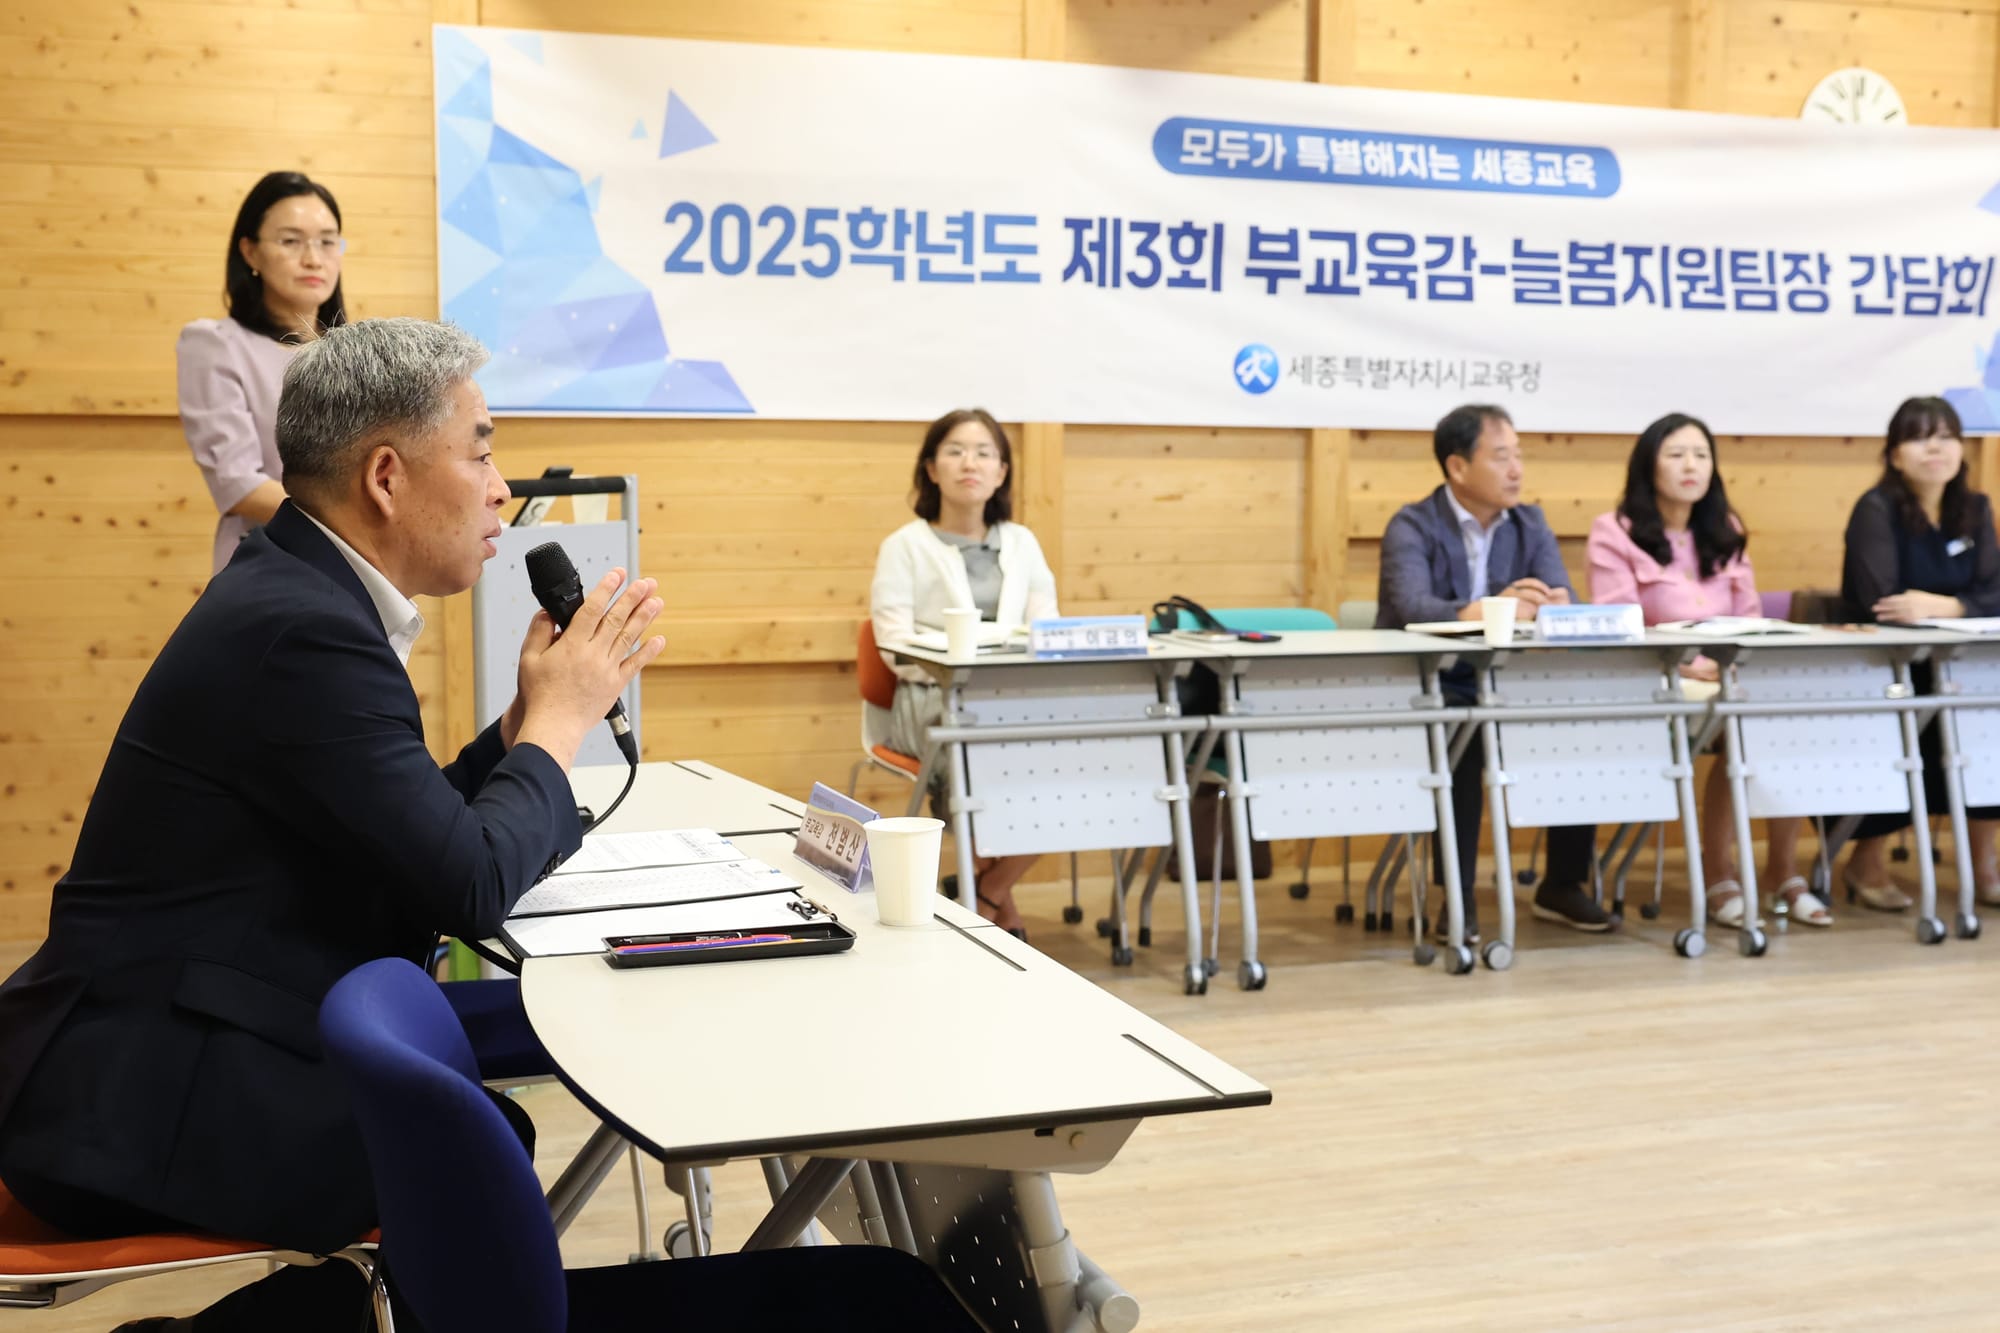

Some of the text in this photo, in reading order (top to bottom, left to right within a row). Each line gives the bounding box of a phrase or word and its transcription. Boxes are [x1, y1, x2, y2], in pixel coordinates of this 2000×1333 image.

[1178, 127, 1598, 191] 모두가 특별해지는 세종교육
[663, 201, 1997, 319] 2025학년도 제3회 부교육감-늘봄지원팀장 간담회
[1287, 354, 1543, 394] 세종특별자치시교육청
